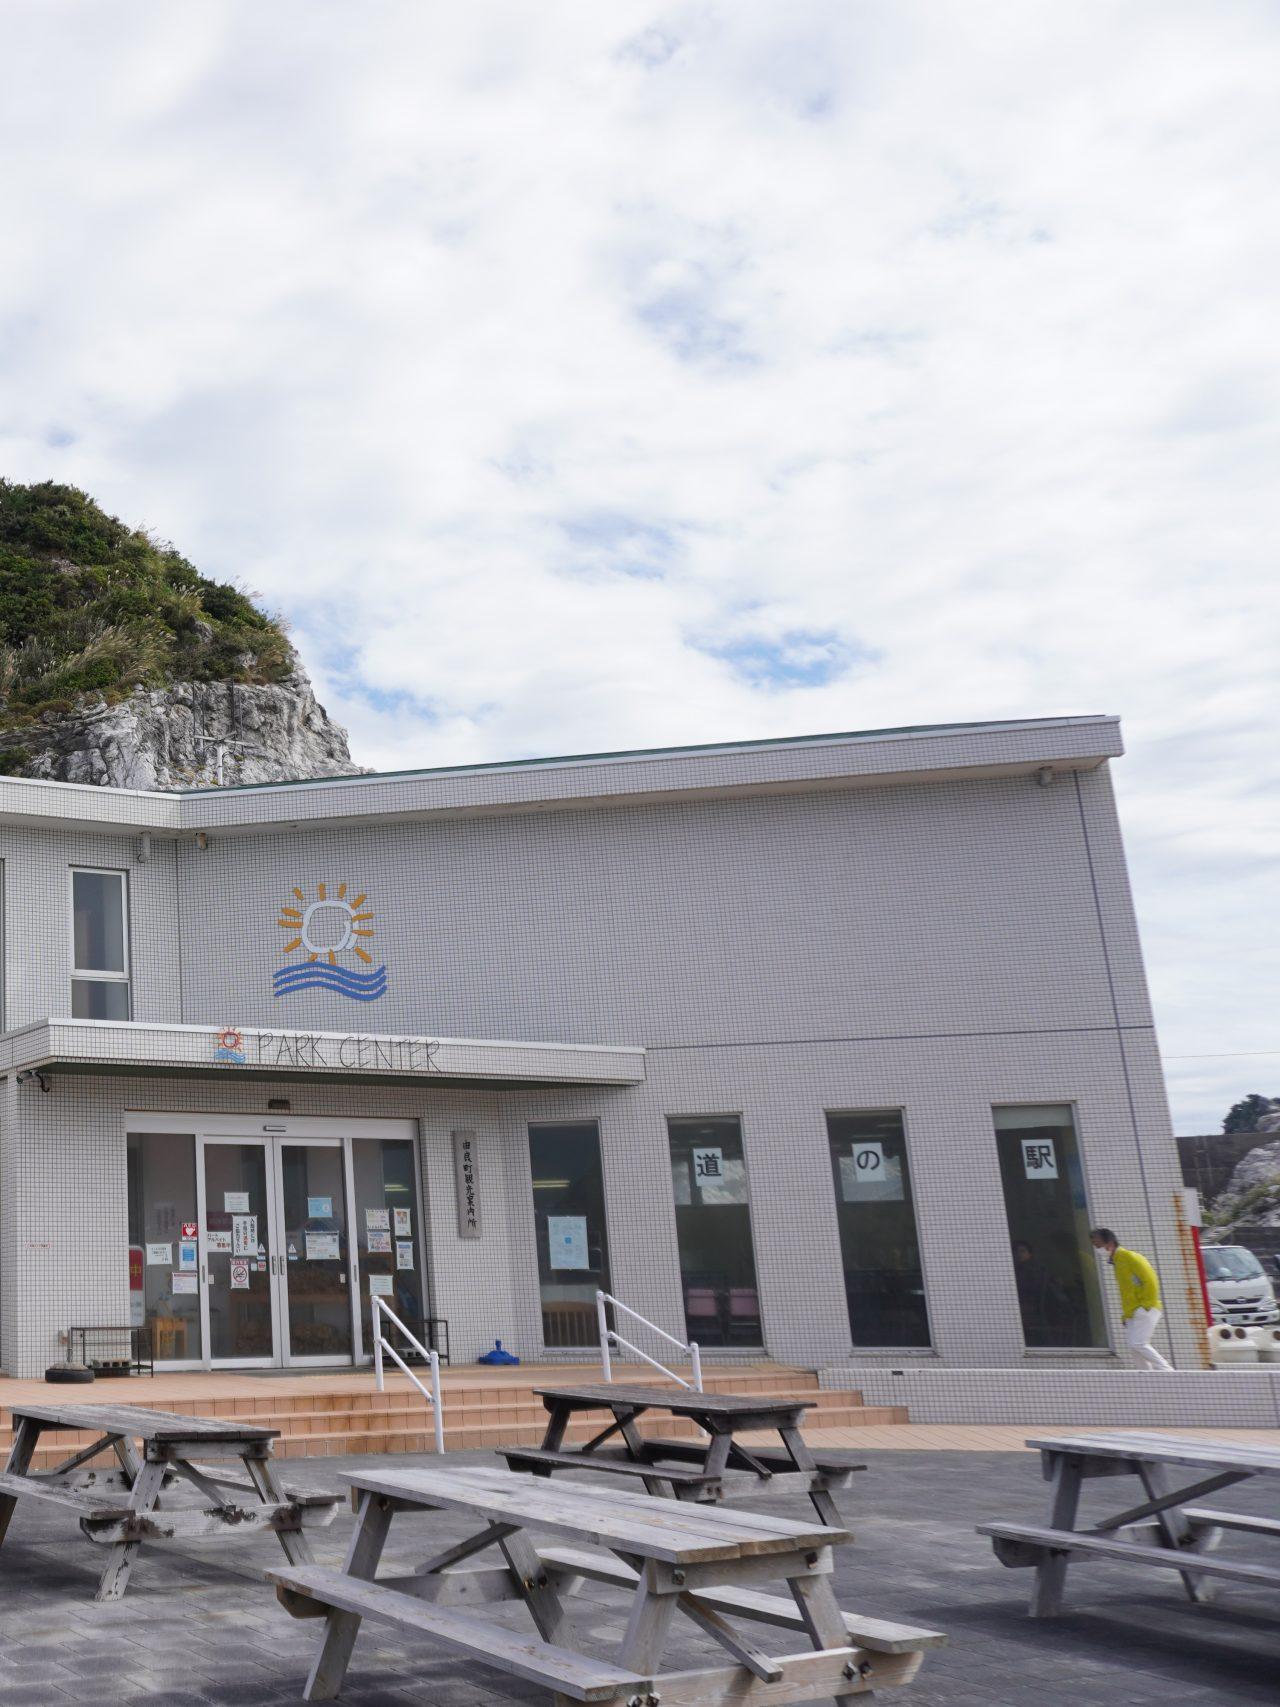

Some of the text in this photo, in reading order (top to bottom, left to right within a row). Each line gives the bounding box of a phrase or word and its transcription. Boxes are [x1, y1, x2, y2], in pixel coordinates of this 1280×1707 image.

[256, 1031, 442, 1073] PARK CENTER
[696, 1145, 1054, 1177] 道 の 駅
[462, 1141, 477, 1229] 由良町観光案内所
